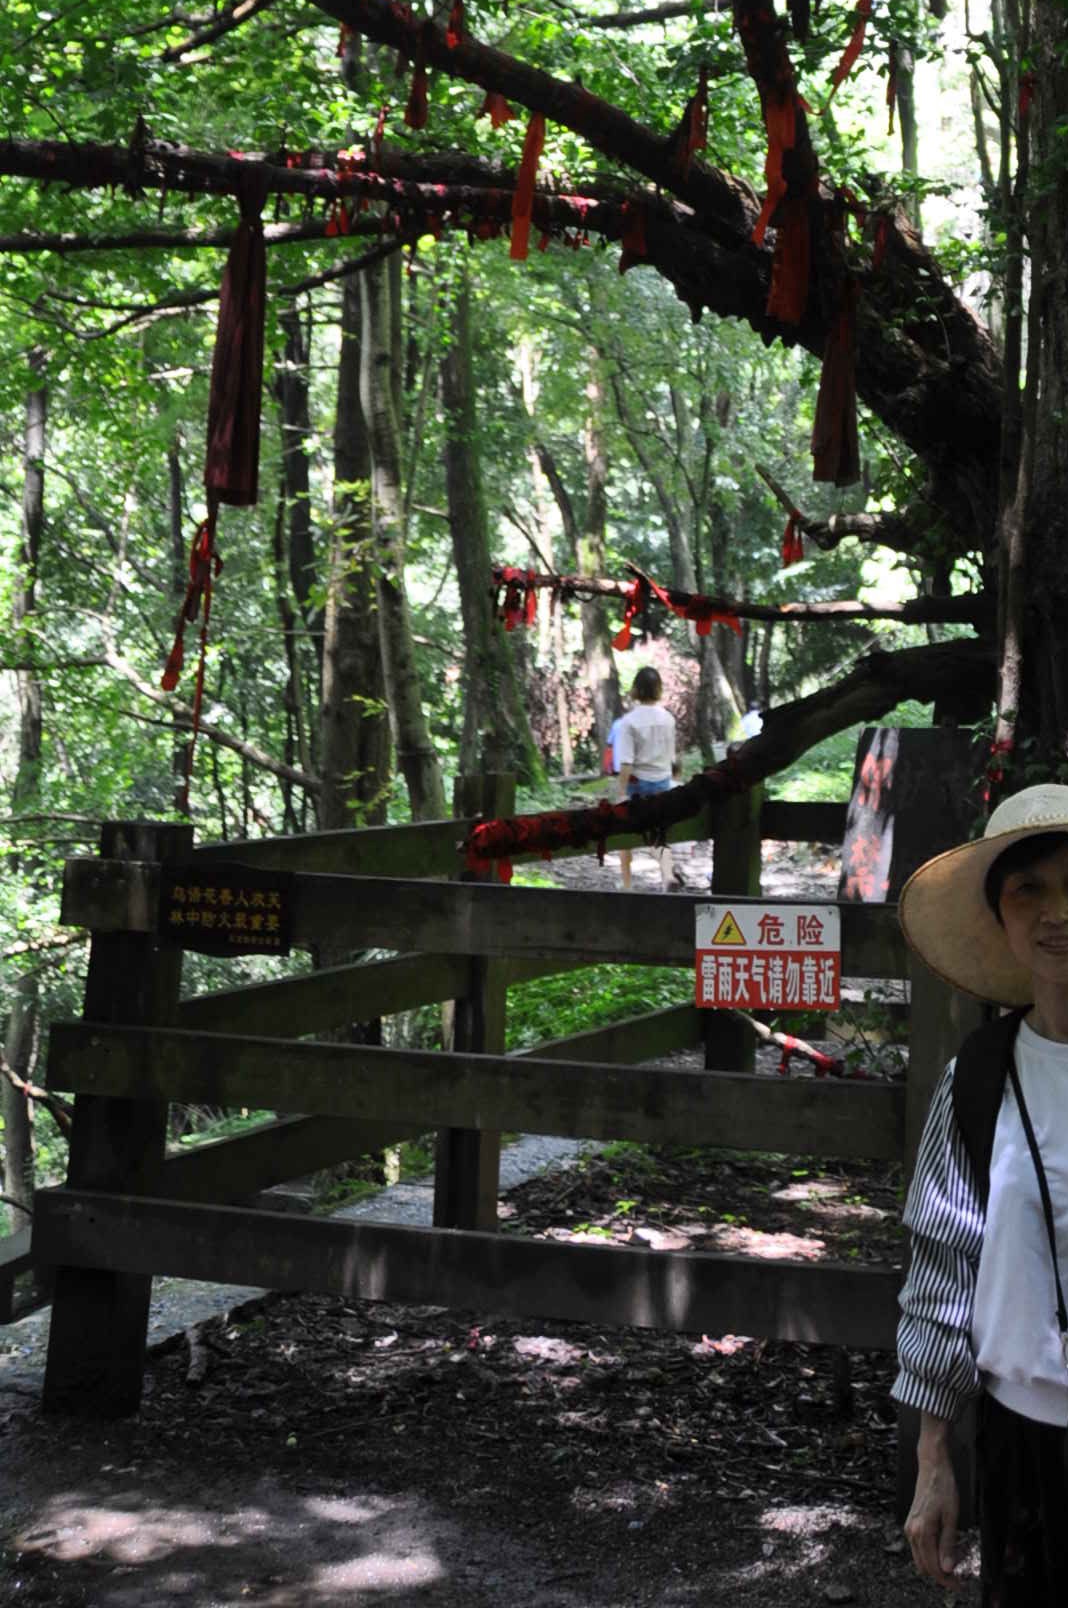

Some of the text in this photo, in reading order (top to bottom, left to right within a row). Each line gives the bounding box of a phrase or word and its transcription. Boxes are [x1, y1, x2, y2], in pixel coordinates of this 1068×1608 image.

[757, 913, 825, 946] 危险
[700, 954, 836, 1006] 雷雨天气请勿靠近
